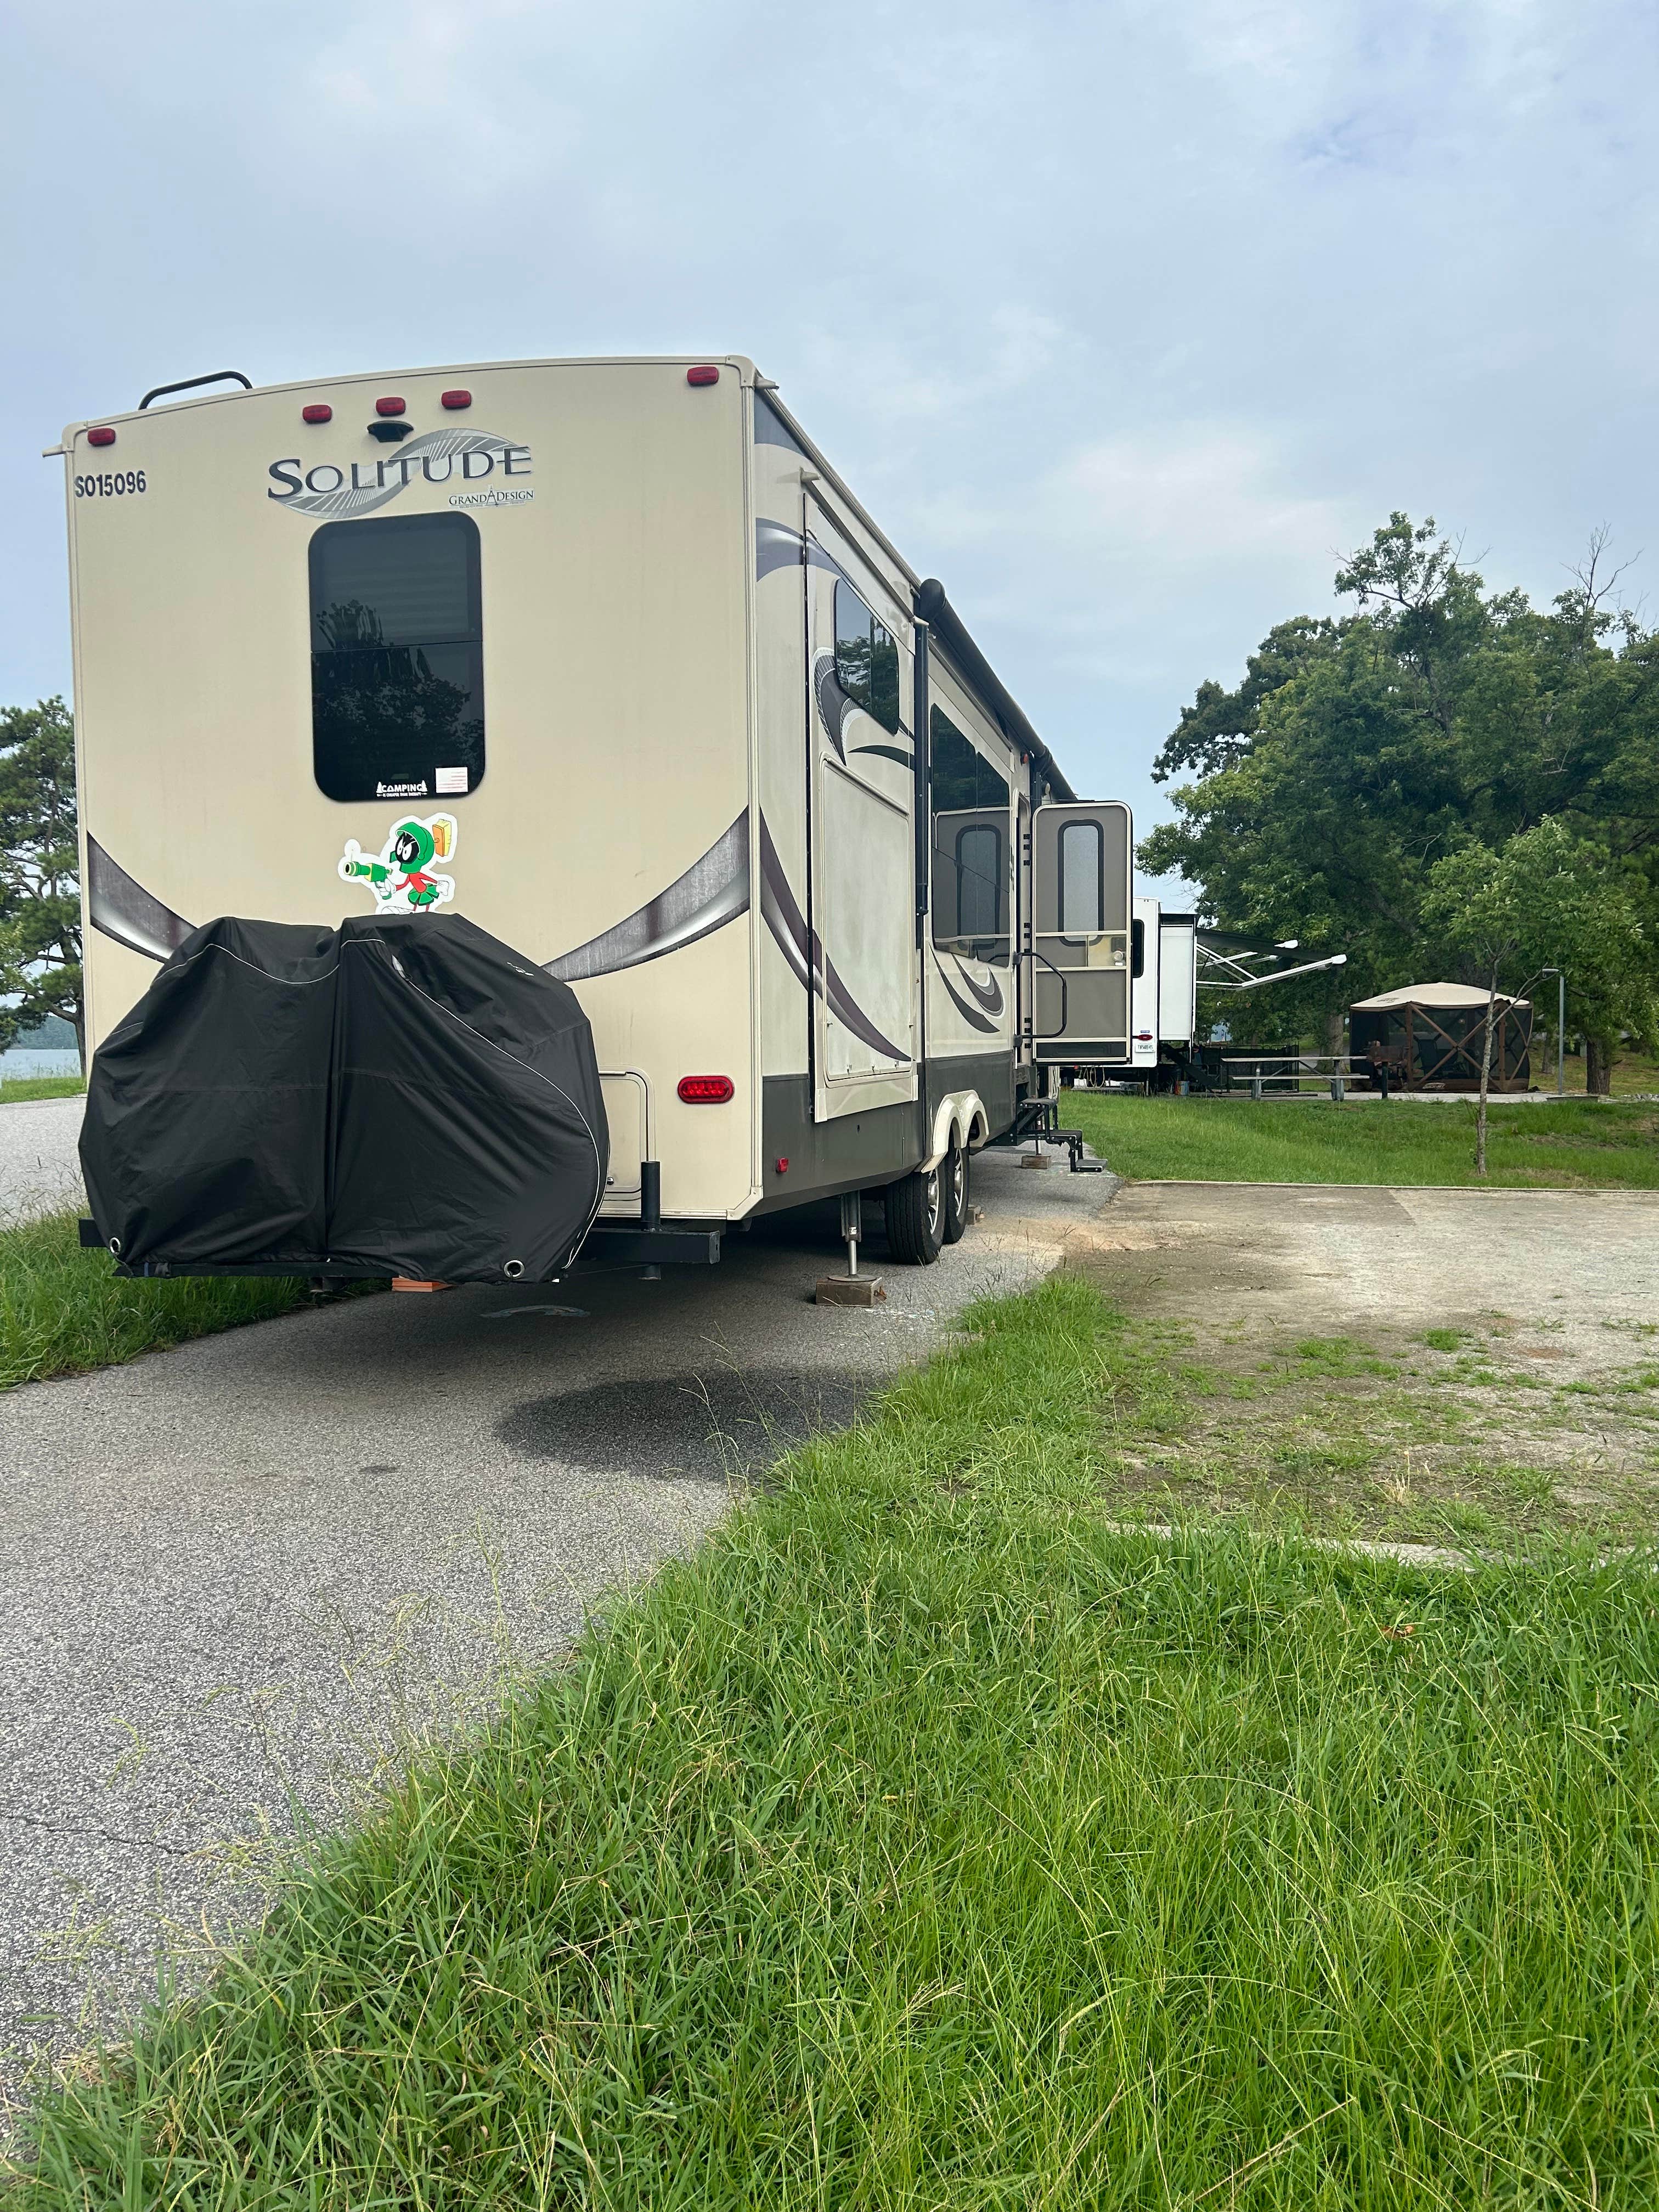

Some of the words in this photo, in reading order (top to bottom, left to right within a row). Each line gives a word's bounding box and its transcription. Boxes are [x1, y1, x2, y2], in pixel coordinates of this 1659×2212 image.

[268, 445, 532, 499] SOLITUDE
[449, 494, 487, 505] GRAND
[496, 490, 534, 501] DESIGN
[381, 783, 422, 792] CAMPING
